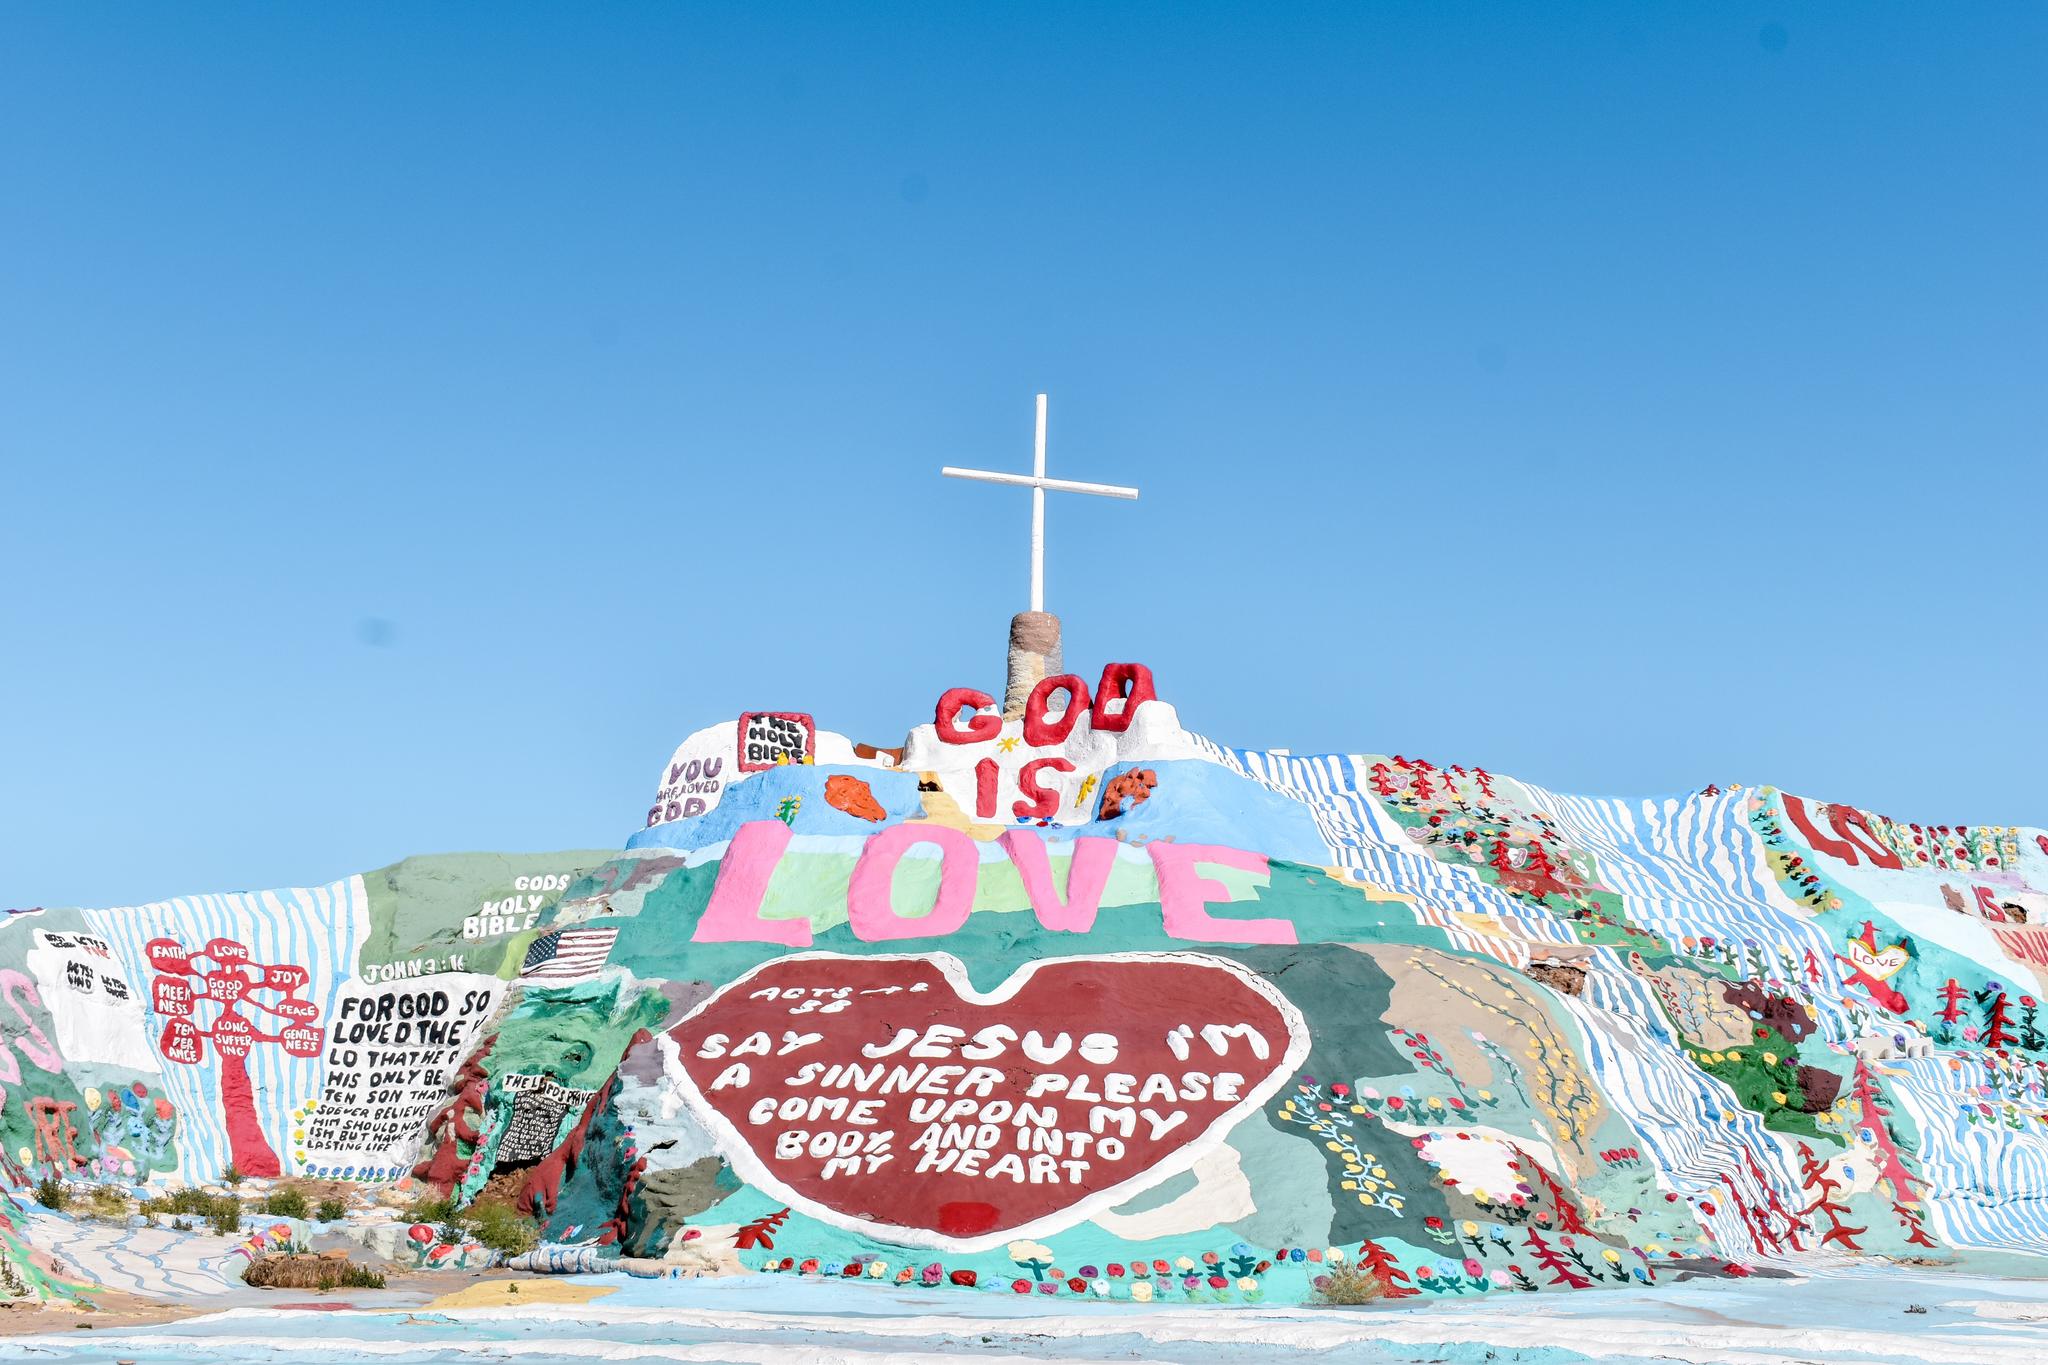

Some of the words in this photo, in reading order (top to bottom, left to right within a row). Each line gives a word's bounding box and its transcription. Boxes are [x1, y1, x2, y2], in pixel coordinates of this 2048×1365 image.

[935, 662, 1157, 746] GOD
[752, 714, 800, 733] THE
[749, 728, 803, 749] HOLY
[748, 743, 804, 764] BIBLE
[669, 757, 722, 785] YOU
[975, 757, 1077, 818] IS
[647, 797, 706, 827] GOD
[515, 874, 570, 891] GODS
[690, 819, 1299, 947] LOVE
[480, 894, 543, 917] HOLY
[1971, 884, 2006, 923] IS
[463, 912, 539, 939] BIBLE
[152, 945, 187, 960] FAITH
[213, 944, 248, 959] LOVE
[1852, 948, 1900, 967] LOVE
[271, 970, 303, 986] JOY
[362, 958, 422, 984] JOHN
[158, 983, 192, 1001] MEEK
[208, 979, 243, 992] GOOD
[749, 987, 853, 1001] ACTS
[211, 989, 239, 1000] NESS
[158, 1000, 189, 1014] NESS
[278, 1004, 316, 1017] PEACE
[341, 992, 396, 1023] FOR
[399, 990, 449, 1019] GOD
[459, 990, 491, 1016] SO
[174, 1022, 196, 1035] TEM
[218, 1021, 249, 1033] LONG
[283, 1029, 320, 1042] GENTLE
[333, 1020, 412, 1044] LOVED
[416, 1019, 467, 1047] THE
[172, 1036, 194, 1050] PER
[215, 1033, 253, 1047] SUFFER
[285, 1040, 318, 1051] NESS
[696, 1031, 824, 1059] SAY
[861, 1024, 1119, 1065] JESUS
[1166, 1023, 1269, 1061] I'M
[168, 1049, 198, 1063] ANCE
[222, 1045, 246, 1056] ING
[367, 1050, 420, 1068] THAT
[420, 1050, 445, 1065] HE
[327, 1071, 362, 1089] HIS
[370, 1069, 421, 1087] ONLY
[505, 1075, 530, 1089] THE
[710, 1062, 751, 1092] A
[784, 1062, 1006, 1097] SINNER
[1025, 1071, 1245, 1104] PLEASE
[325, 1088, 356, 1105] TEN
[366, 1089, 403, 1104] SON
[316, 1104, 369, 1118] SOEVER
[749, 1096, 887, 1125] COME
[908, 1098, 1058, 1128] UPON
[1089, 1105, 1188, 1141] MY
[309, 1127, 334, 1140] ISH
[339, 1130, 370, 1142] BUT
[313, 1118, 340, 1127] HIM
[343, 1119, 398, 1134] SHOULD
[307, 1140, 362, 1151] LASTING
[366, 1143, 393, 1152] LIFE
[909, 1122, 1001, 1150] AND
[1016, 1126, 1125, 1161] INTO
[820, 1153, 895, 1181] MY
[914, 1148, 1090, 1184] HEART
